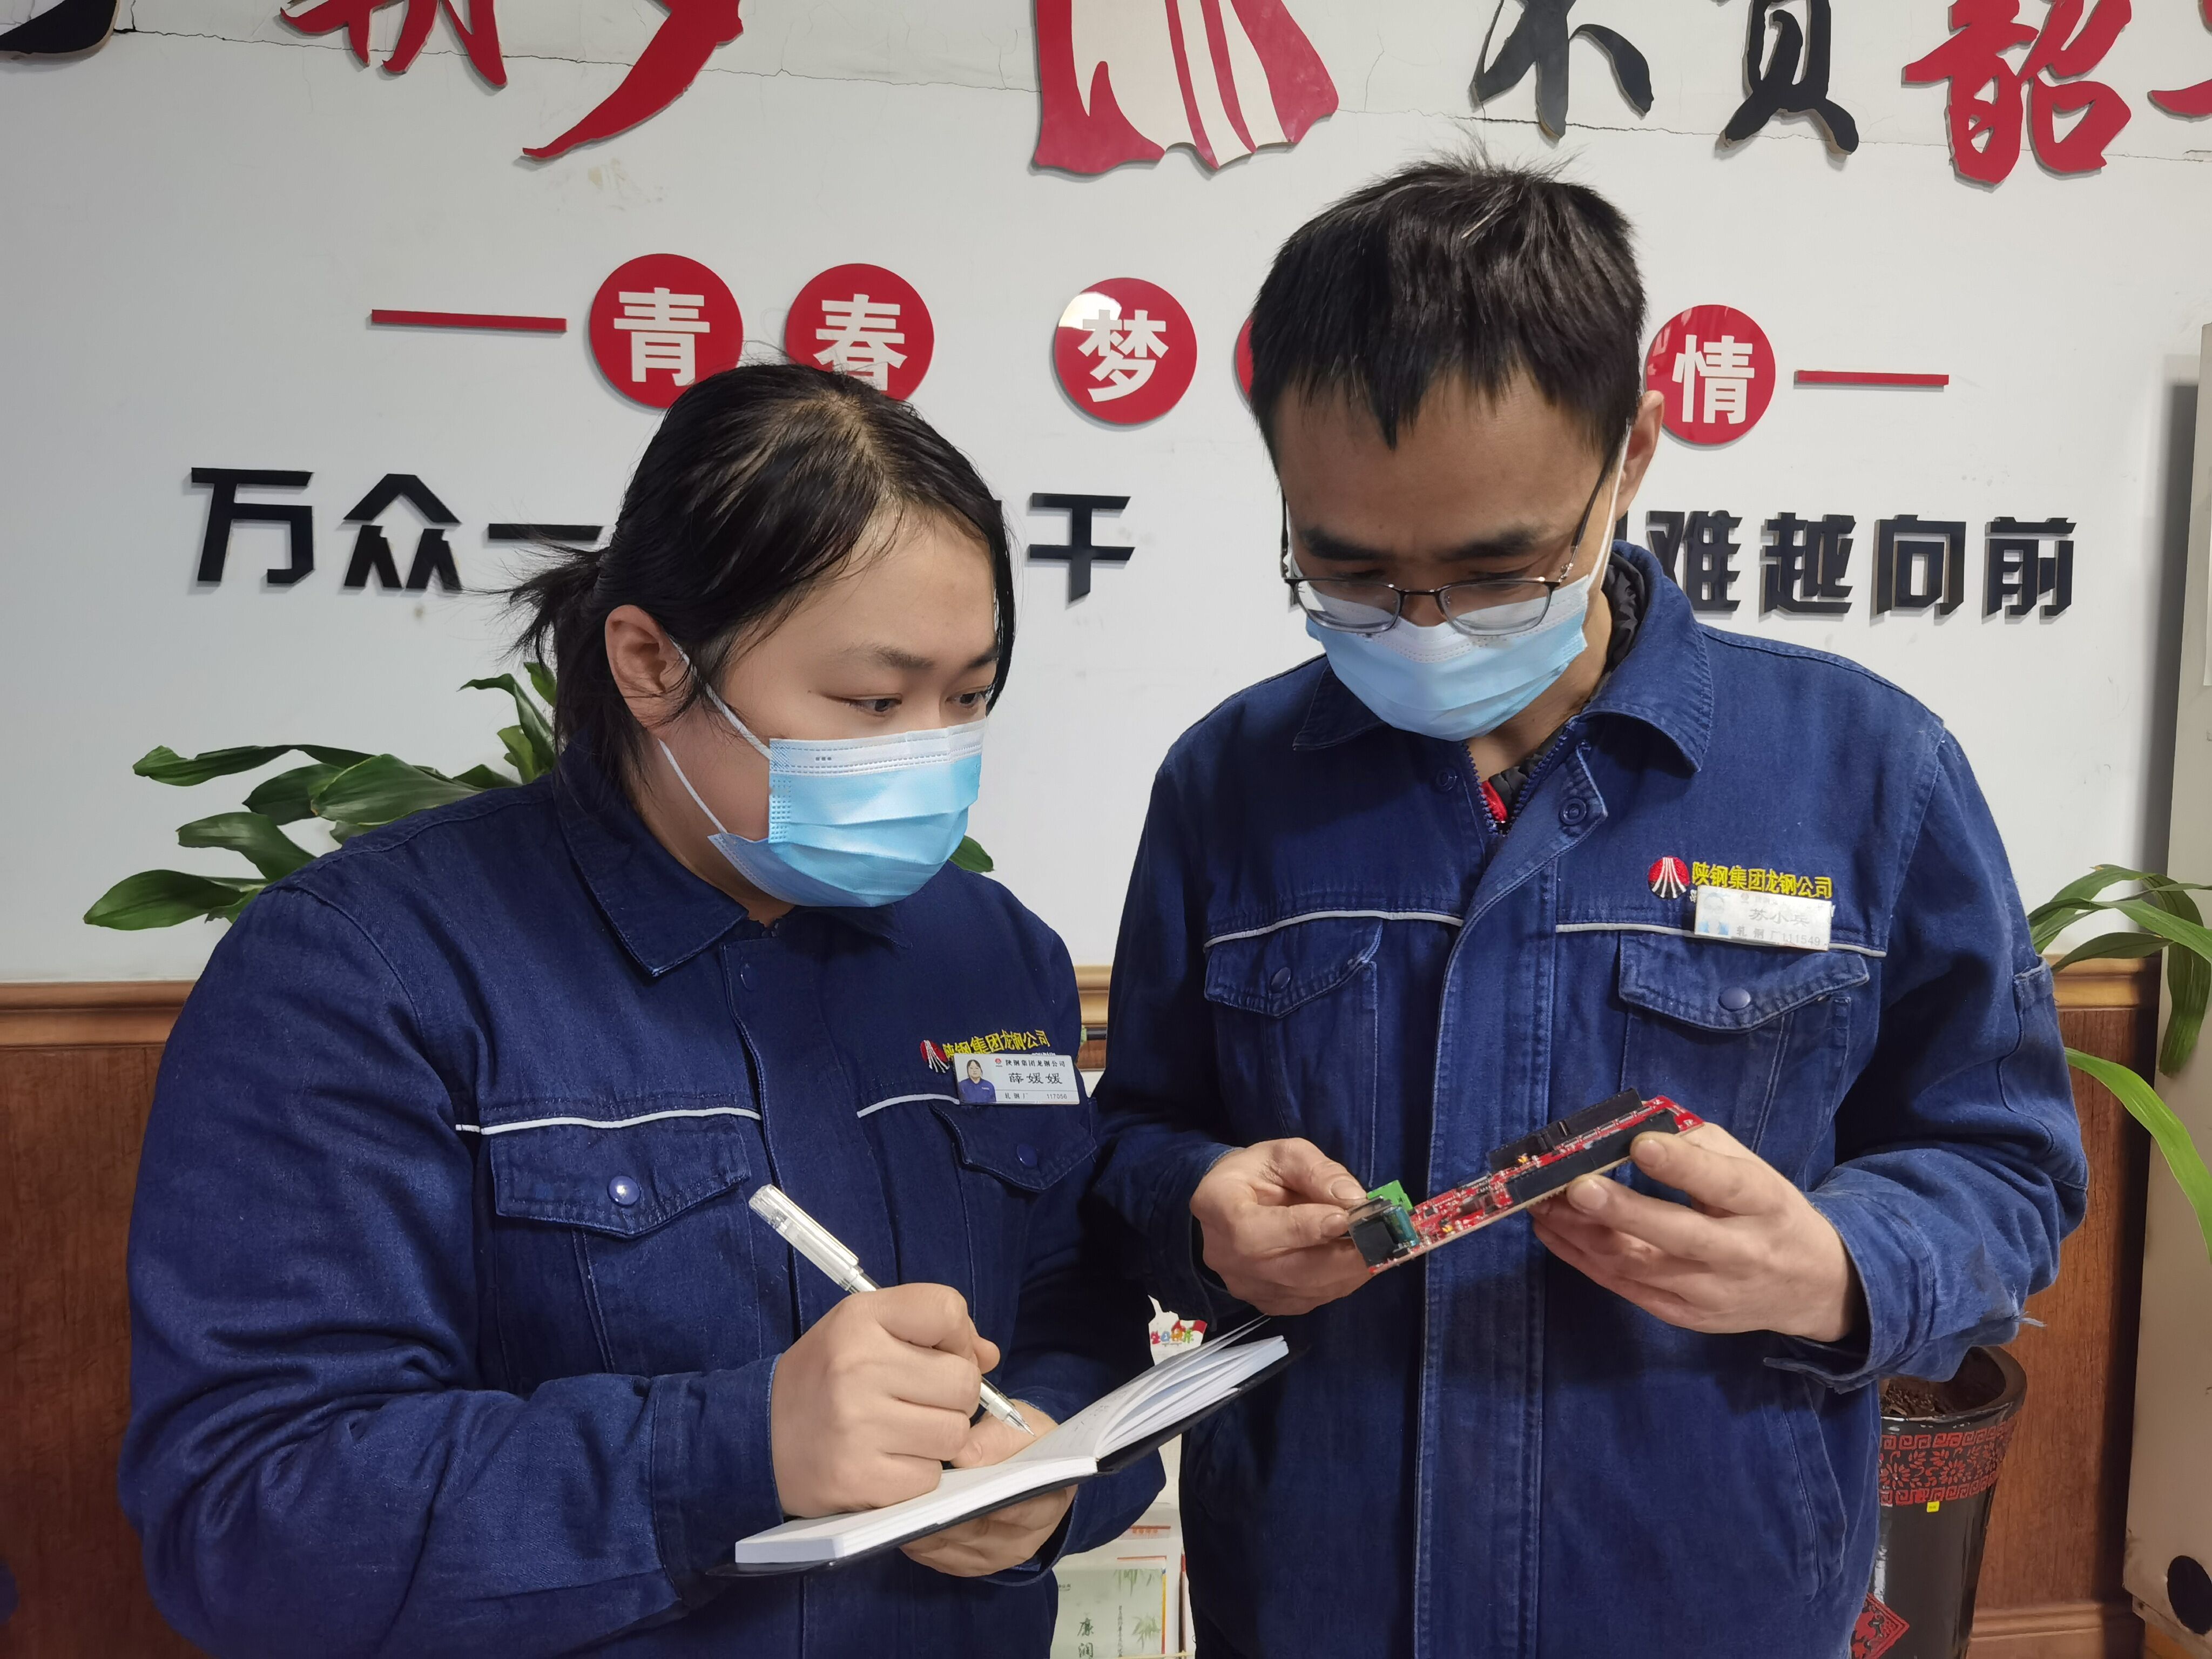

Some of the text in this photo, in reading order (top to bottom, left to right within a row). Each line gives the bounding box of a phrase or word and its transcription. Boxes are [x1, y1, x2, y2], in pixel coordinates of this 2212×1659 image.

[613, 287, 1755, 424] 青春 梦 情
[1615, 510, 2077, 616] 难越向前
